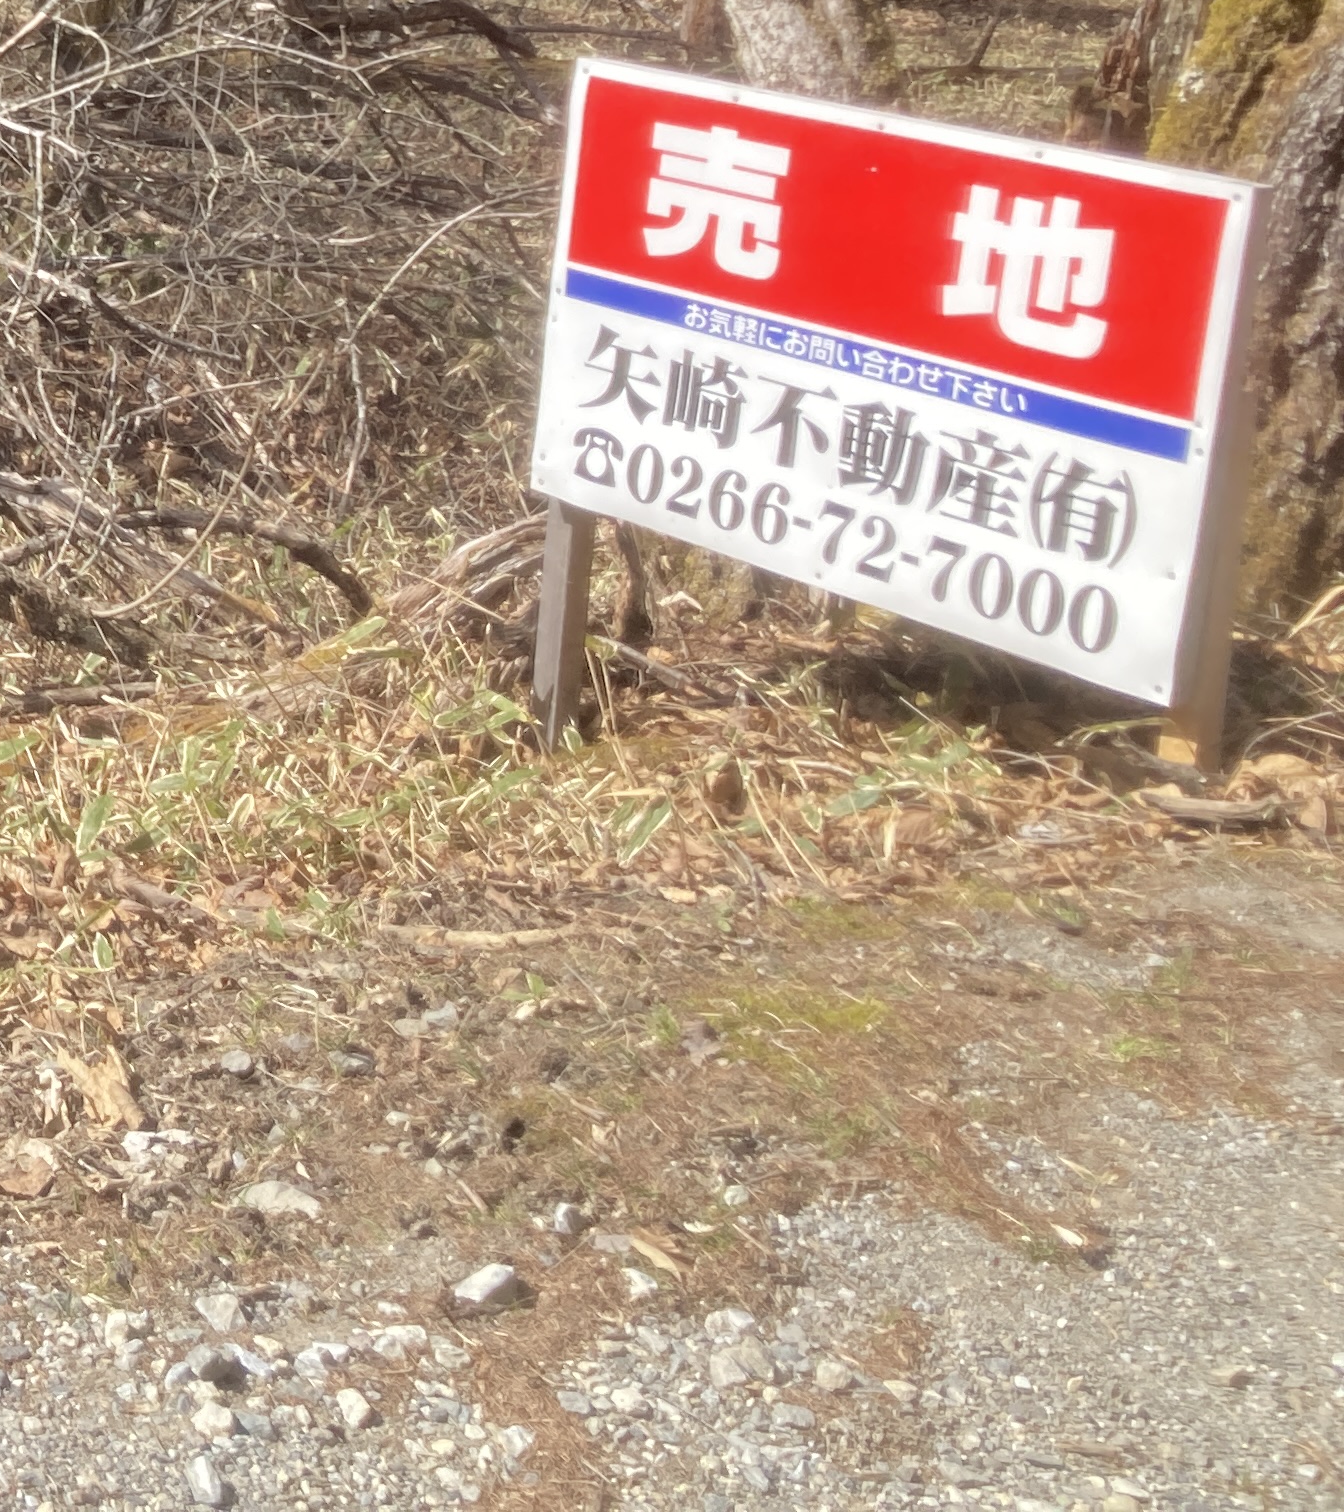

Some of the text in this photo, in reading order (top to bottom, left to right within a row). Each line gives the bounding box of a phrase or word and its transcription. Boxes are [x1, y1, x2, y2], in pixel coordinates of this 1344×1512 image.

[642, 121, 1116, 360] 売地
[683, 302, 1029, 416] お気軽にお問い合わせ下さい
[624, 441, 1119, 656] 0266-72-7000
